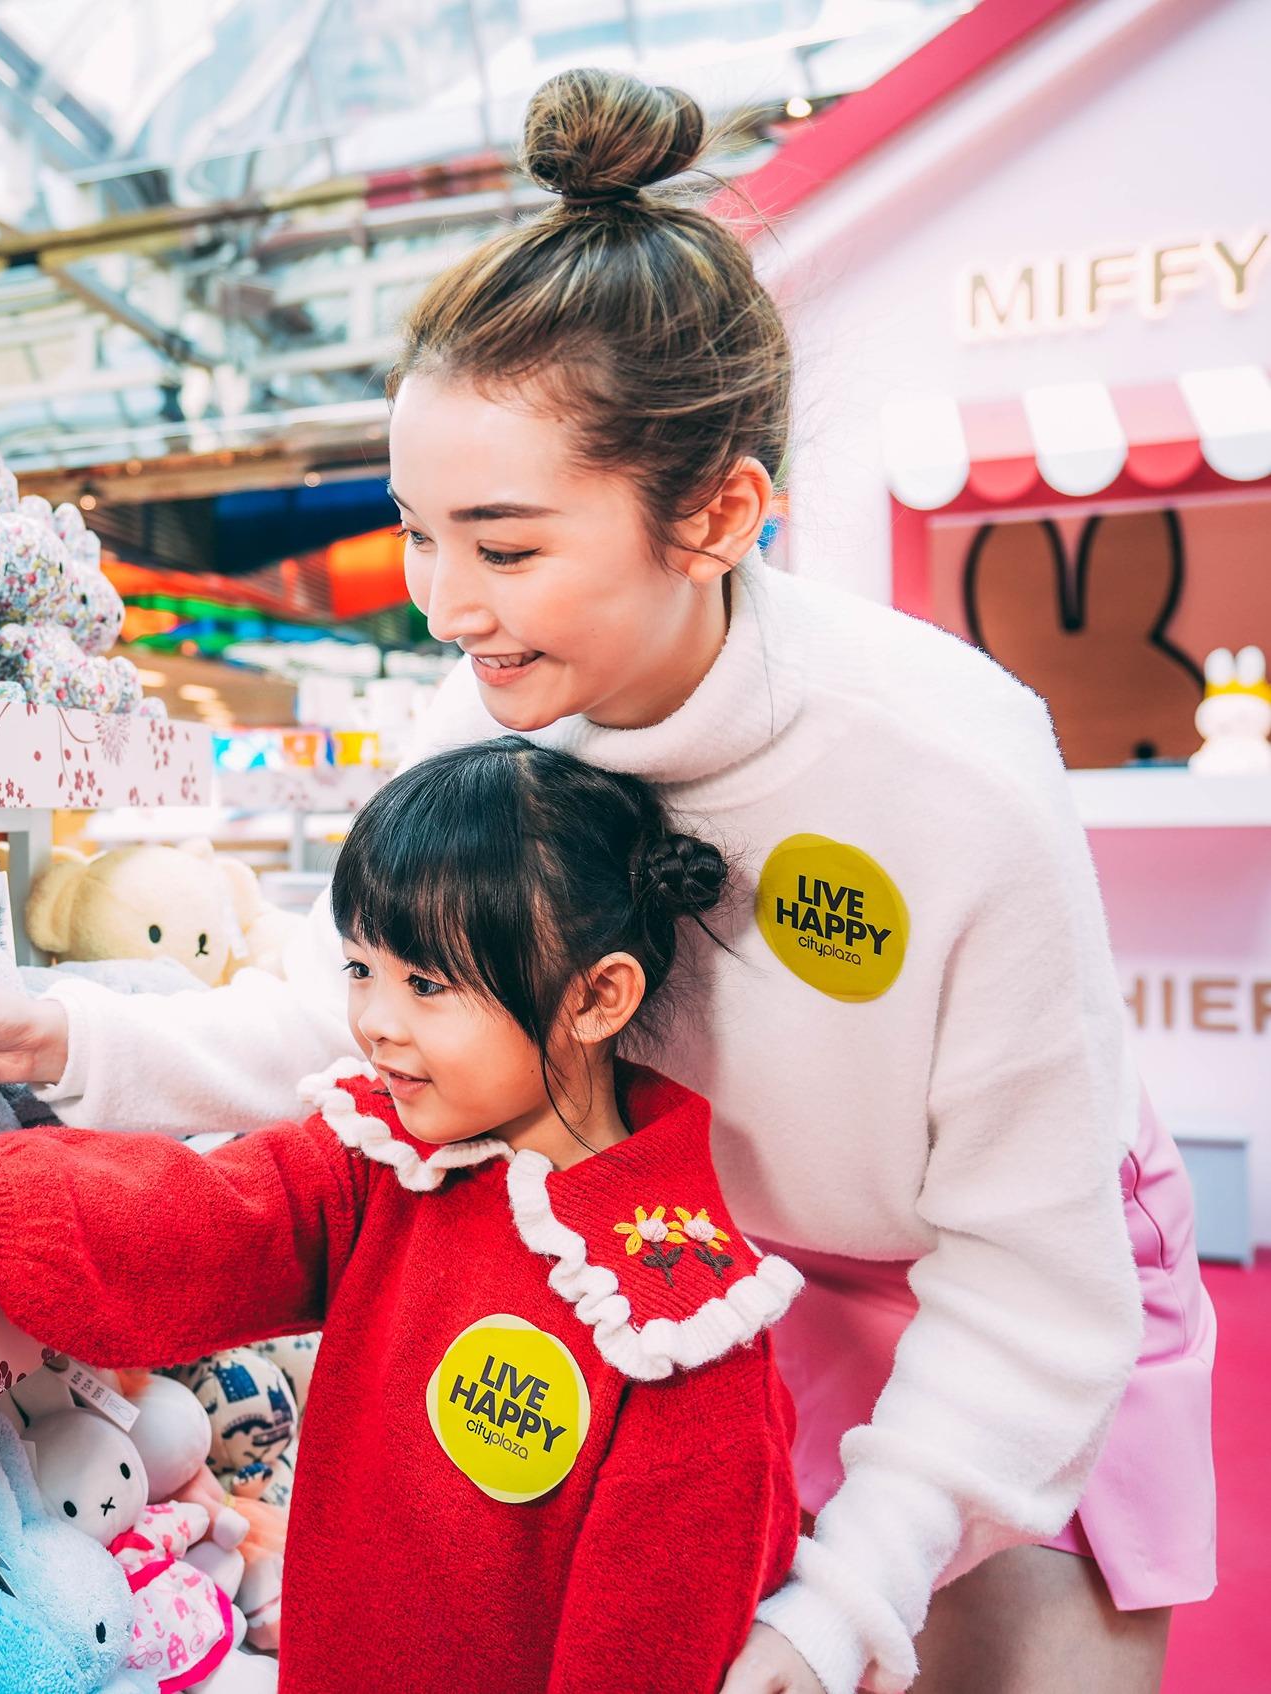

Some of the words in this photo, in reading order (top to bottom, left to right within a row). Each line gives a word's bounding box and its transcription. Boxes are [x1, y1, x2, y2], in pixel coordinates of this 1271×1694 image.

[971, 234, 1269, 328] MIFFY
[798, 875, 864, 919] LIVE
[776, 897, 892, 955] HAPPY
[798, 935, 861, 966] cityplaza
[70, 1371, 83, 1385] BON
[81, 1378, 93, 1392] TON
[91, 1386, 105, 1400] TOYS
[479, 1355, 550, 1411] LIVE
[449, 1374, 567, 1453] HAPPY
[466, 1418, 529, 1460] cityplaza
